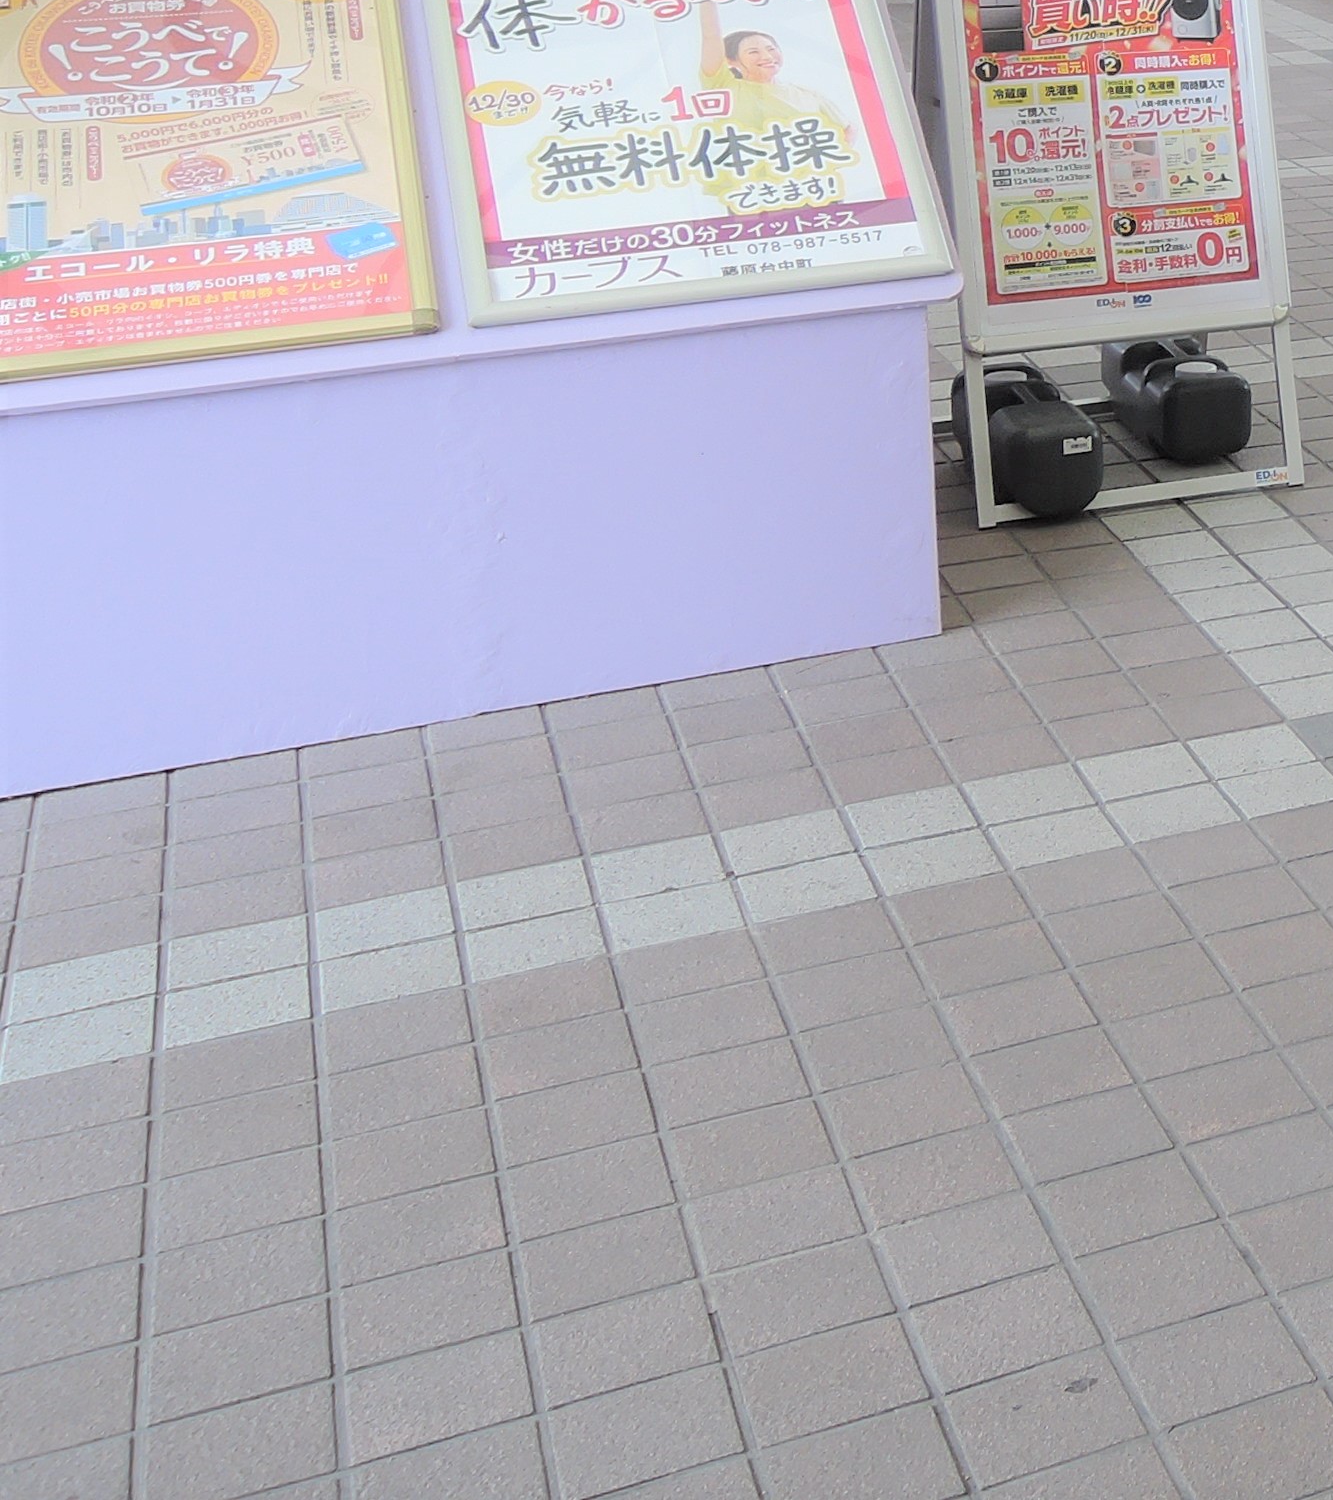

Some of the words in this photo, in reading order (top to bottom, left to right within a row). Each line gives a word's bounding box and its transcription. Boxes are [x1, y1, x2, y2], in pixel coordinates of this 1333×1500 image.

[109, 0, 186, 14] お買物券
[70, 19, 233, 52] こうべで
[1002, 61, 1087, 77] ポイントで還元!
[85, 102, 167, 118] 10月10日
[187, 95, 256, 109] 1月31日
[468, 91, 535, 114] 12/30
[1038, 126, 1085, 139] ポイント
[537, 118, 851, 196] 無料体操
[1041, 138, 1088, 160] 還元!
[728, 176, 837, 209] できます!
[1118, 217, 1132, 233] 3
[507, 209, 861, 265] 女性だけの30分フィットネス
[698, 242, 738, 259] TEL
[746, 229, 883, 256] 078-987-5517
[24, 237, 317, 283] エコール・リラ特典
[515, 254, 684, 299] カーブス
